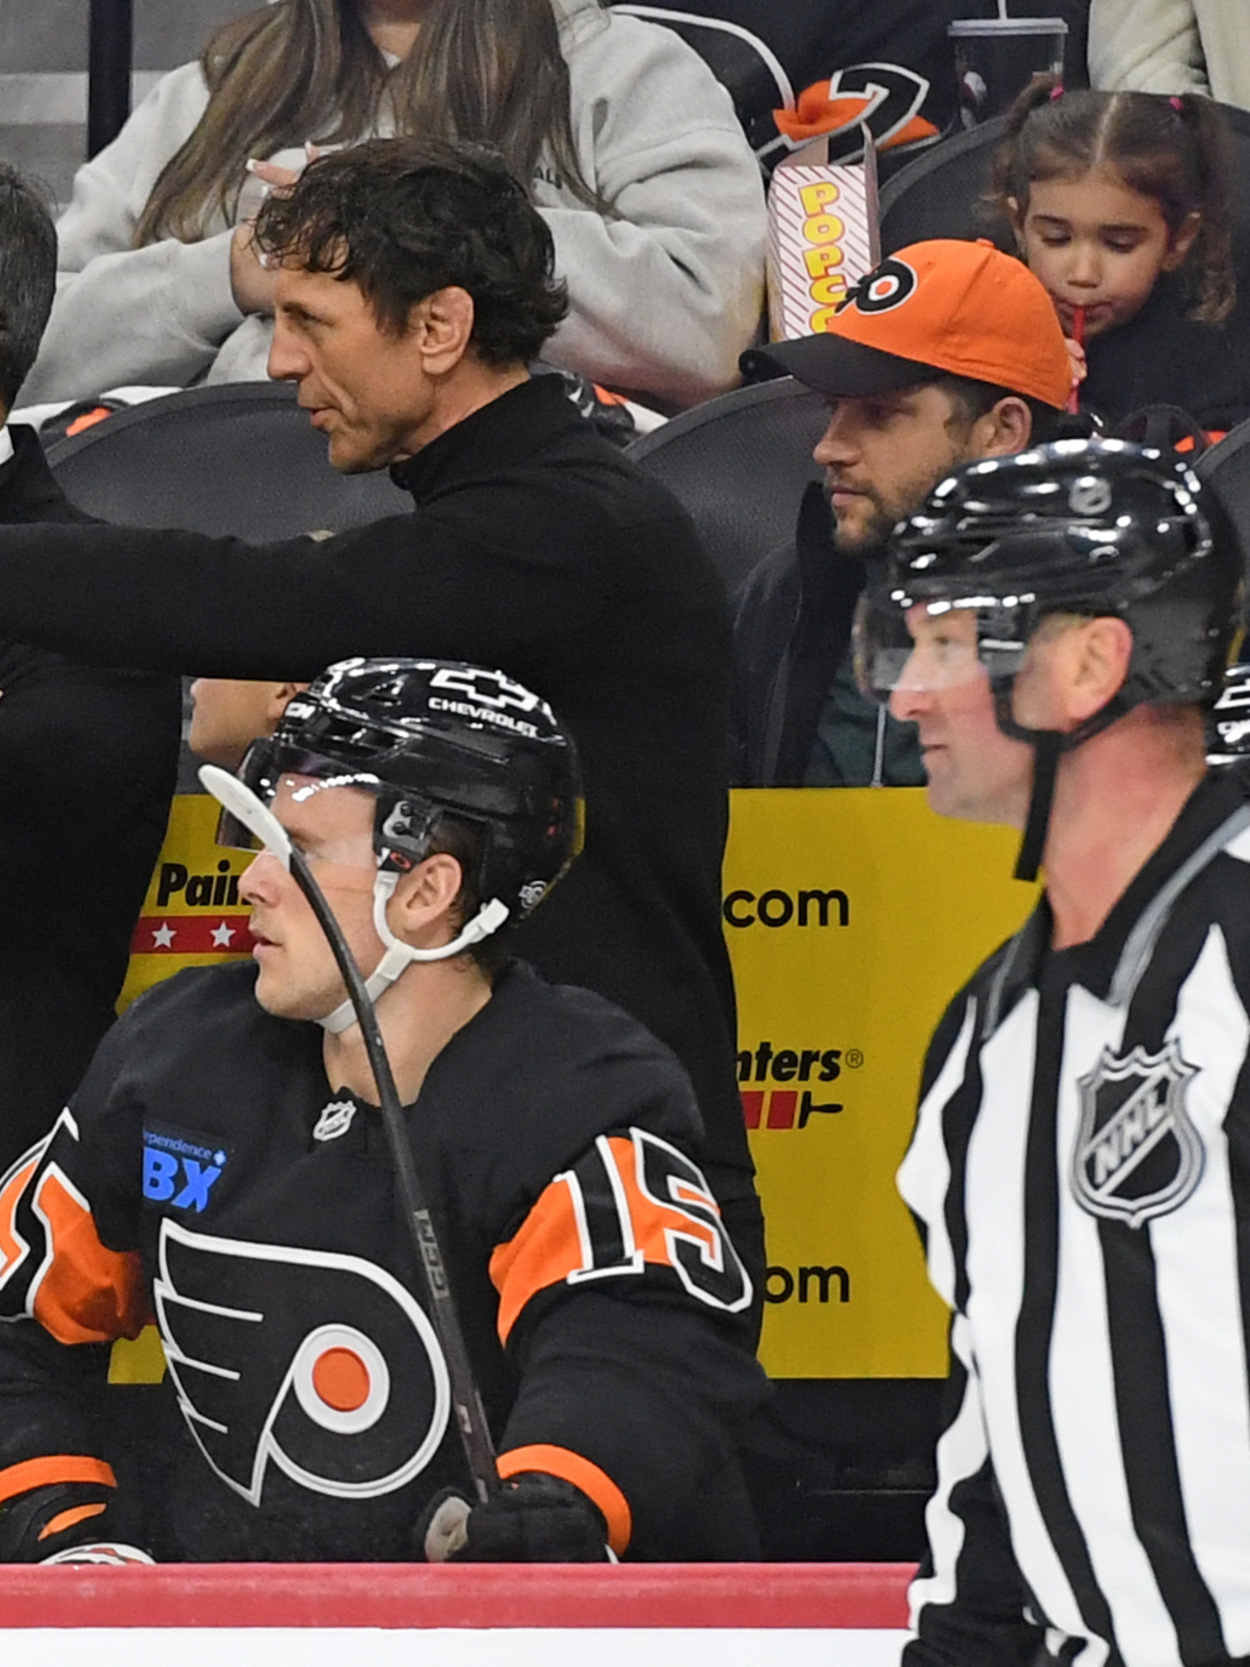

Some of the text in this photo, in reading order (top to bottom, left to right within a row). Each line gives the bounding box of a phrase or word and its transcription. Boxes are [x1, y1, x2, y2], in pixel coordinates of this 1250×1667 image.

[428, 697, 539, 738] CHEVROLET
[723, 889, 849, 928] com
[144, 1131, 212, 1160] pendence
[1093, 1085, 1169, 1185] NHL
[553, 1126, 754, 1313] 15
